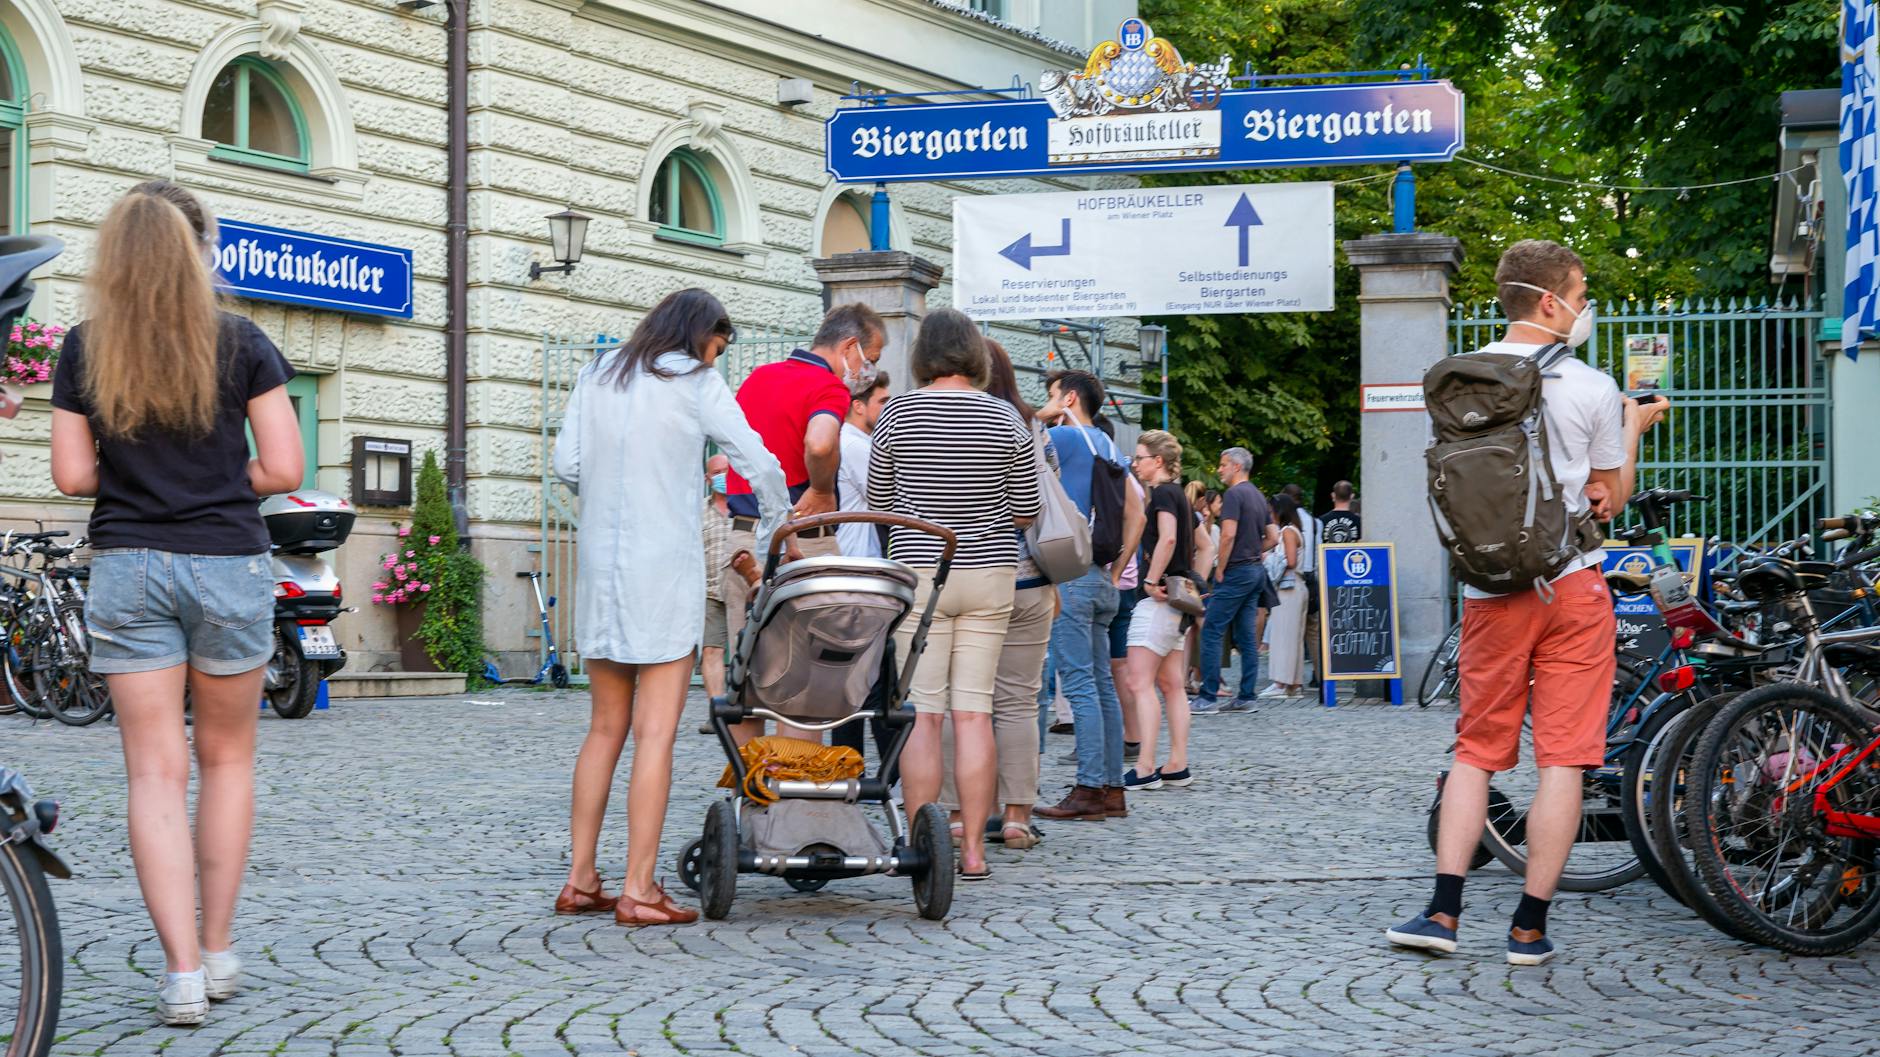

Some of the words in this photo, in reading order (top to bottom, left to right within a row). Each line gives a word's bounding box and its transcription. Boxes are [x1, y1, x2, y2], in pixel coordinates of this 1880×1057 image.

[1243, 103, 1433, 144] Biergarten
[1068, 117, 1203, 147] Hofbräukeller
[851, 121, 1029, 160] Biergarten
[1077, 193, 1204, 211] HOFBRÄUKELLER
[1107, 213, 1120, 221] am
[1123, 211, 1151, 220] Wiener
[1153, 210, 1174, 219] Platz
[1178, 269, 1288, 283] Selbstbedienungs
[1002, 278, 1096, 291] Reservierungen
[972, 294, 999, 305] Lokal
[1002, 293, 1021, 304] und
[1023, 292, 1070, 303] bedienter
[1073, 290, 1127, 301] Biergarten
[1200, 286, 1266, 300] Biergarten
[998, 305, 1017, 315] NUR
[1019, 304, 1037, 314] über
[1066, 303, 1096, 313] Wiener
[1097, 302, 1124, 312] Straße
[1126, 301, 1138, 311] 19)
[1165, 301, 1201, 312] (Eingang
[1203, 301, 1222, 310] NUR
[1224, 299, 1243, 309] über
[1245, 298, 1275, 308] Wiener
[1277, 297, 1301, 307] Platz)
[1350, 562, 1366, 574] HB
[1335, 585, 1373, 609] BIER
[1330, 608, 1388, 630] GARTEN
